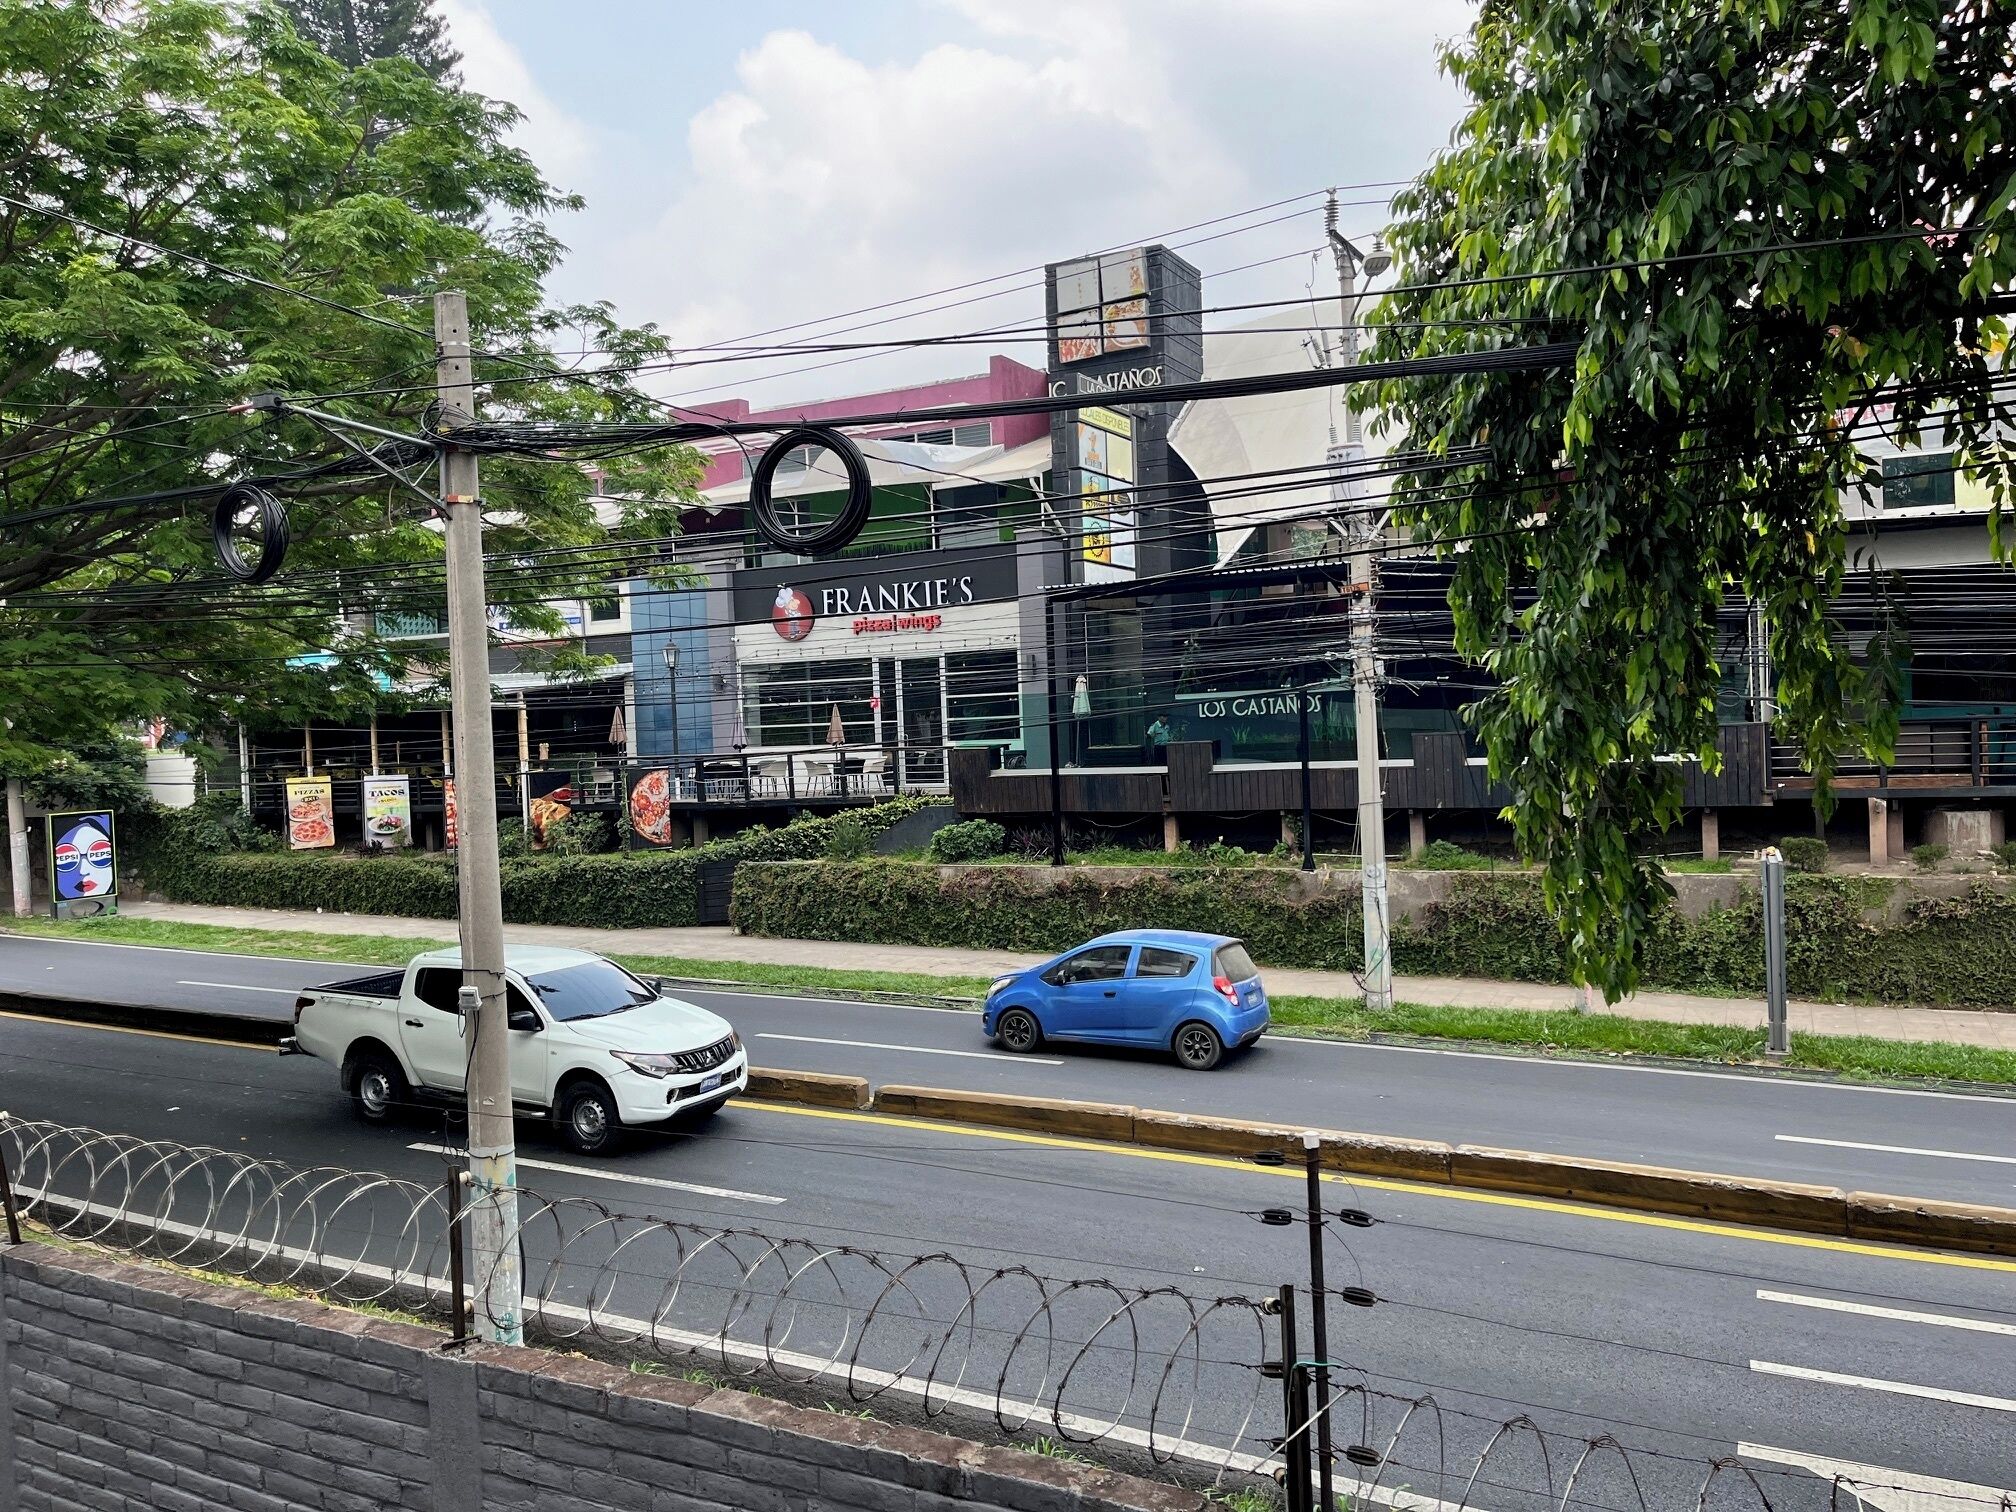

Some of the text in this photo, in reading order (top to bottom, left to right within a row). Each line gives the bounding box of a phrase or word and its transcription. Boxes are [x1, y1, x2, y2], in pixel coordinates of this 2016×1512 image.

[1096, 366, 1163, 391] ASTAÑOS
[821, 576, 973, 615] FRANKIE'S
[1199, 694, 1322, 718] LOS CASTAÑOS
[368, 789, 405, 797] TACOS
[89, 850, 111, 859] PEPS
